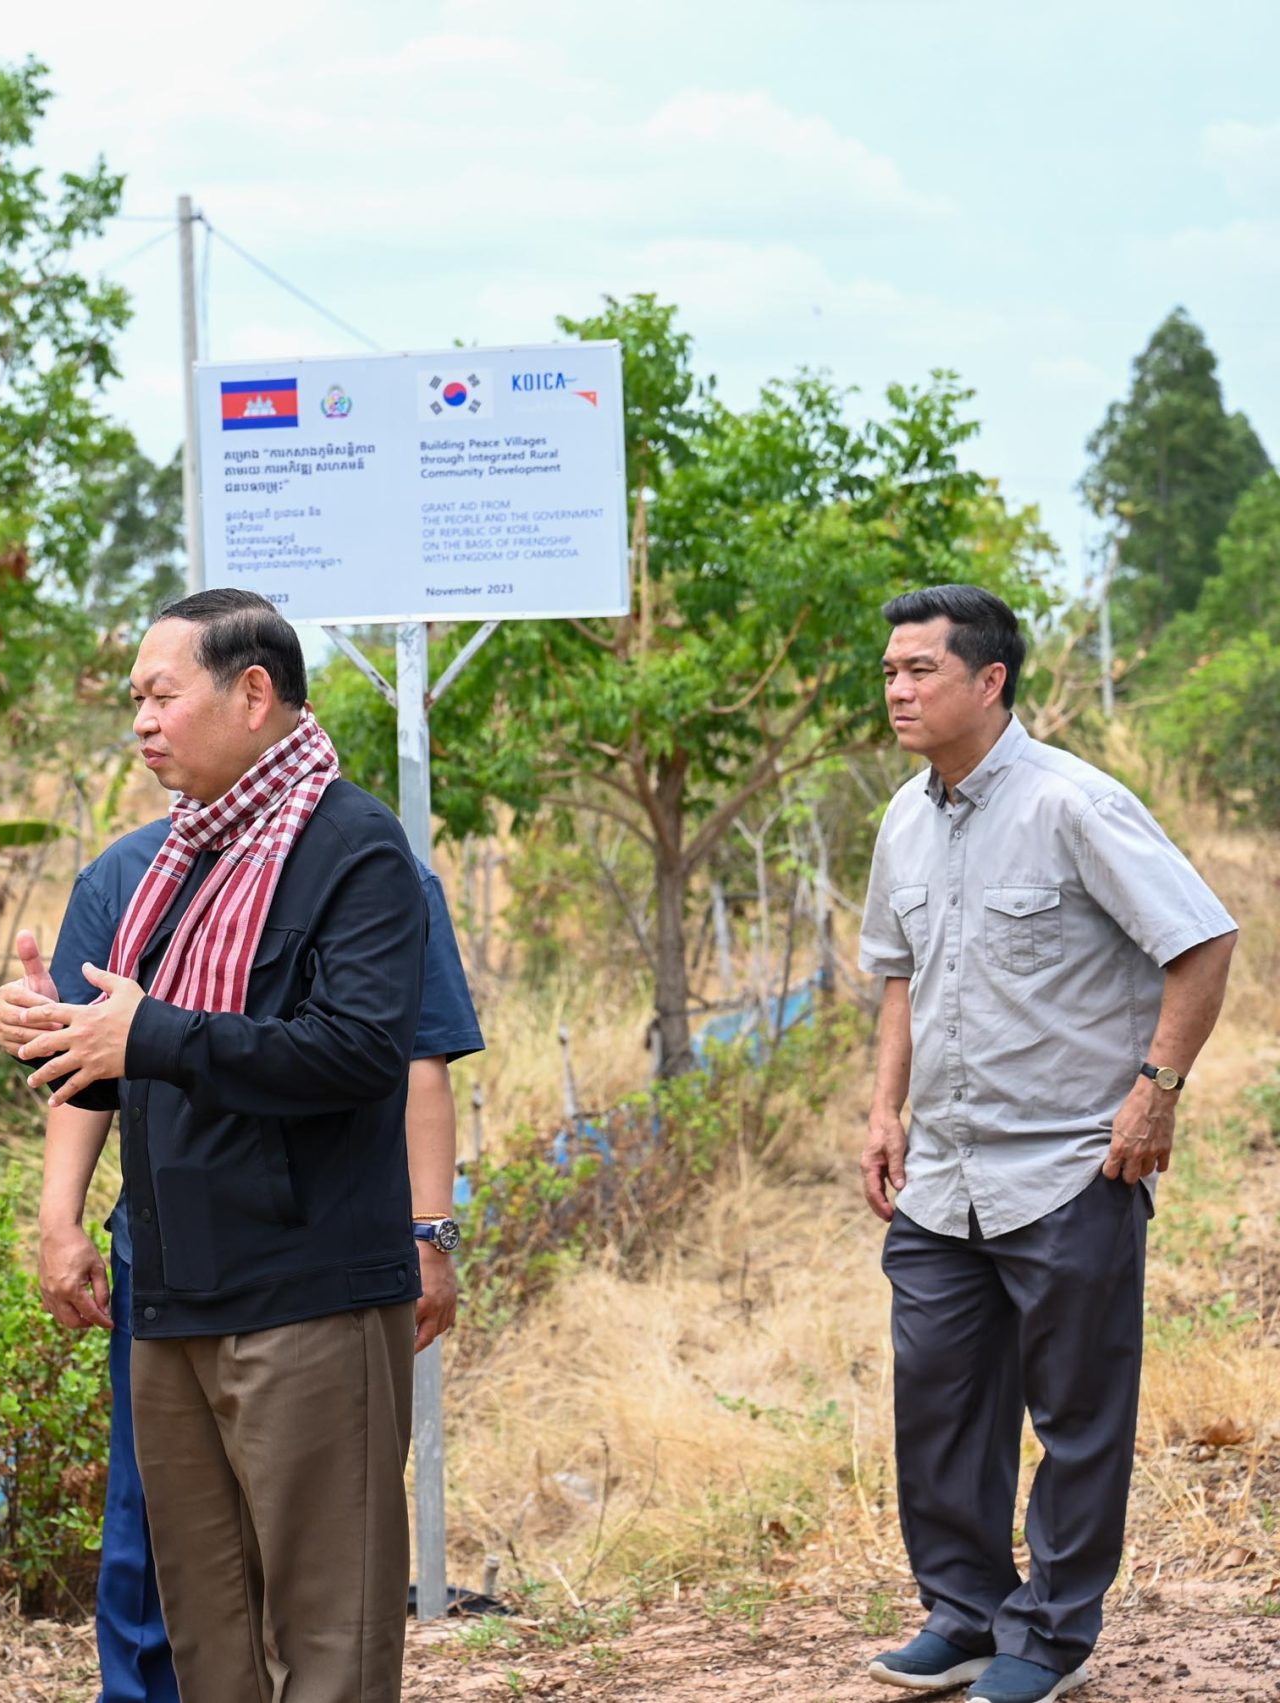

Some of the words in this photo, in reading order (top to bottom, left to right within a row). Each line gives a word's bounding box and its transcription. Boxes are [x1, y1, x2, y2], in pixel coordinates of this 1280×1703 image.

[512, 372, 566, 391] KOICA
[421, 441, 464, 451] Building
[470, 440, 499, 448] Peace
[504, 437, 547, 447] Villages
[421, 455, 464, 465] through
[469, 452, 525, 463] Integrated
[530, 450, 558, 459] Rural
[421, 469, 483, 479] Community
[489, 464, 560, 475] Development
[421, 503, 455, 513] GRANT
[460, 502, 477, 511] AID
[481, 501, 510, 509] FROM
[422, 516, 440, 525] THE
[445, 515, 480, 524] PEOPLE
[484, 513, 506, 522] AND
[511, 512, 528, 521] THE
[533, 509, 604, 521] GOVERNMENT
[423, 529, 435, 538] OF
[440, 527, 485, 537] REPUBLIC
[489, 526, 502, 535] OF
[506, 525, 540, 533] KOREA
[423, 542, 439, 550] ON
[443, 540, 461, 549] THE
[465, 539, 492, 549] BASIS
[496, 539, 509, 547] OF
[513, 537, 571, 546] FRIENDSHIP
[423, 554, 449, 563] WITH
[453, 552, 503, 562] KINGDOM
[506, 551, 519, 559] OF
[524, 549, 579, 559] CAMBODIA
[426, 586, 482, 596] November
[488, 584, 513, 593] 2023
